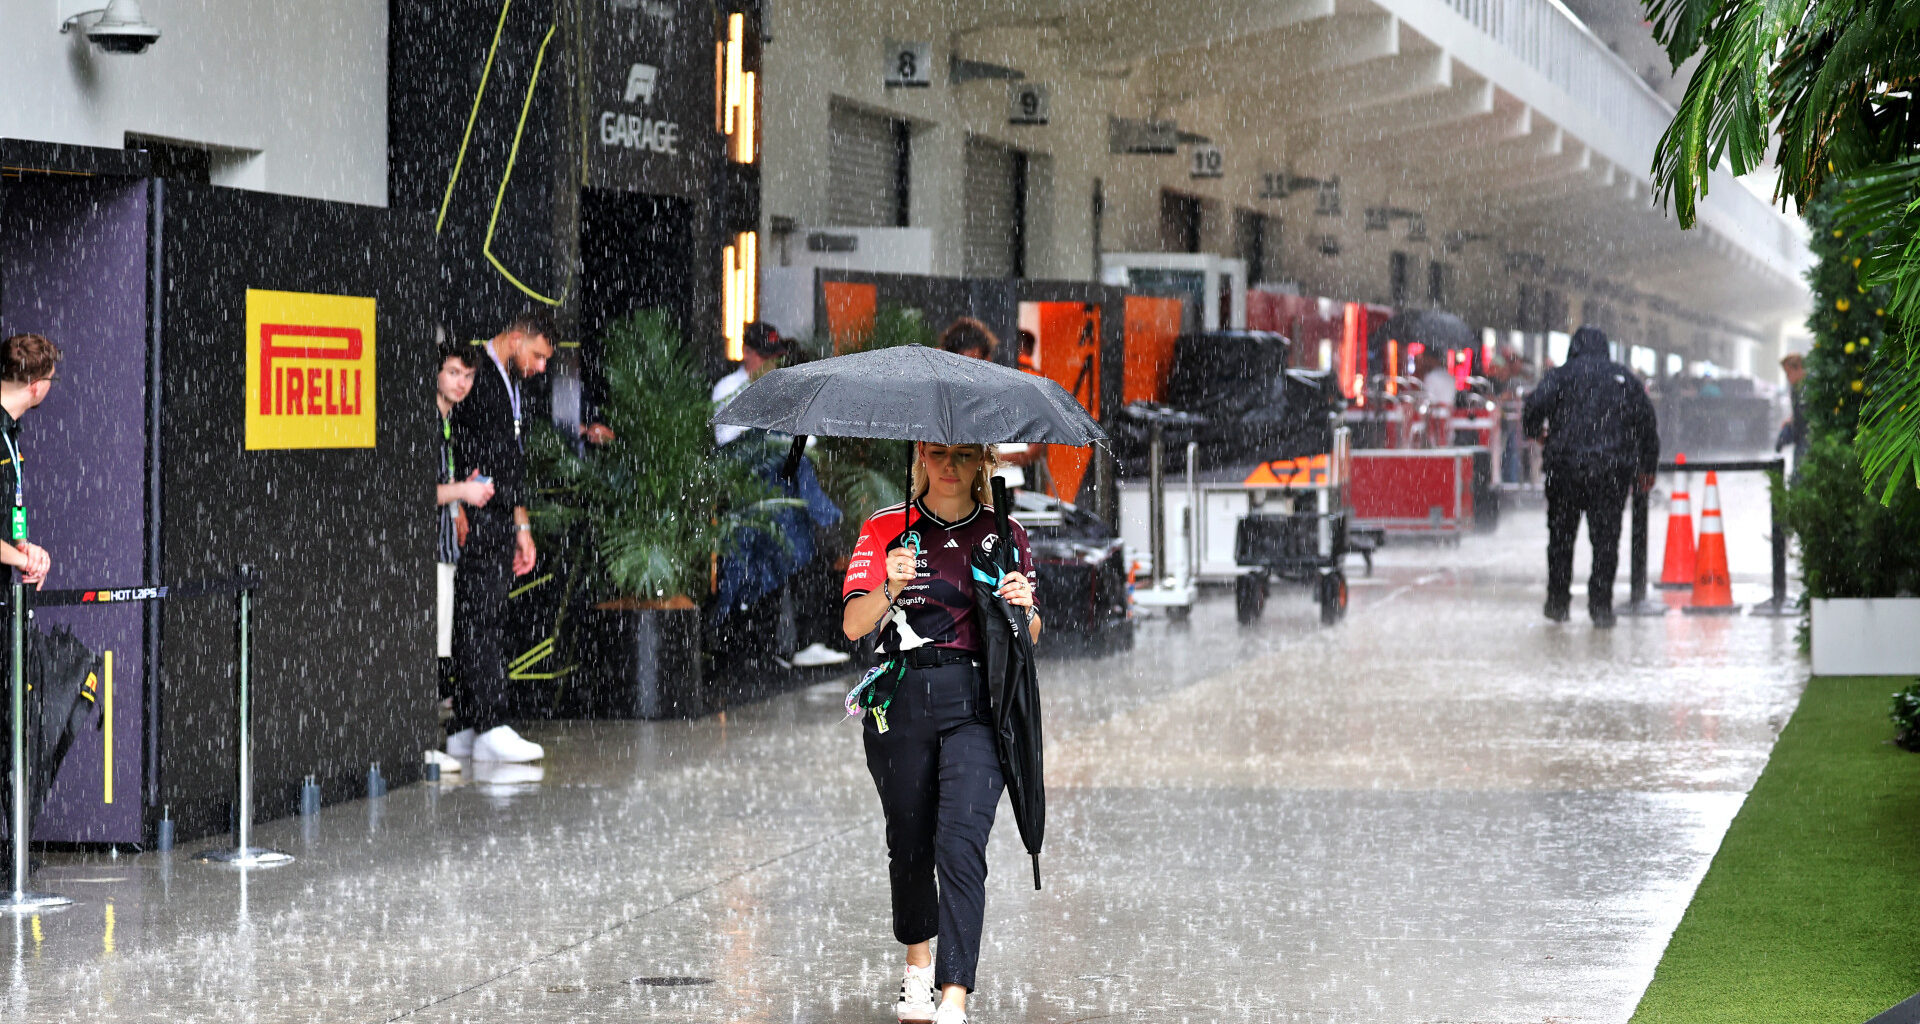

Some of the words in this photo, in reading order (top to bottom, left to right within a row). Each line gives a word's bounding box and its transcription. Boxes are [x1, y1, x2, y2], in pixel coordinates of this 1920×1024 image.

[898, 51, 916, 77] 8
[1021, 91, 1038, 115] 9
[600, 110, 679, 155] GARAGE
[1194, 149, 1222, 170] 10
[260, 323, 363, 416] PIRELLI
[847, 570, 867, 582] nuvei
[110, 590, 131, 601] HOT
